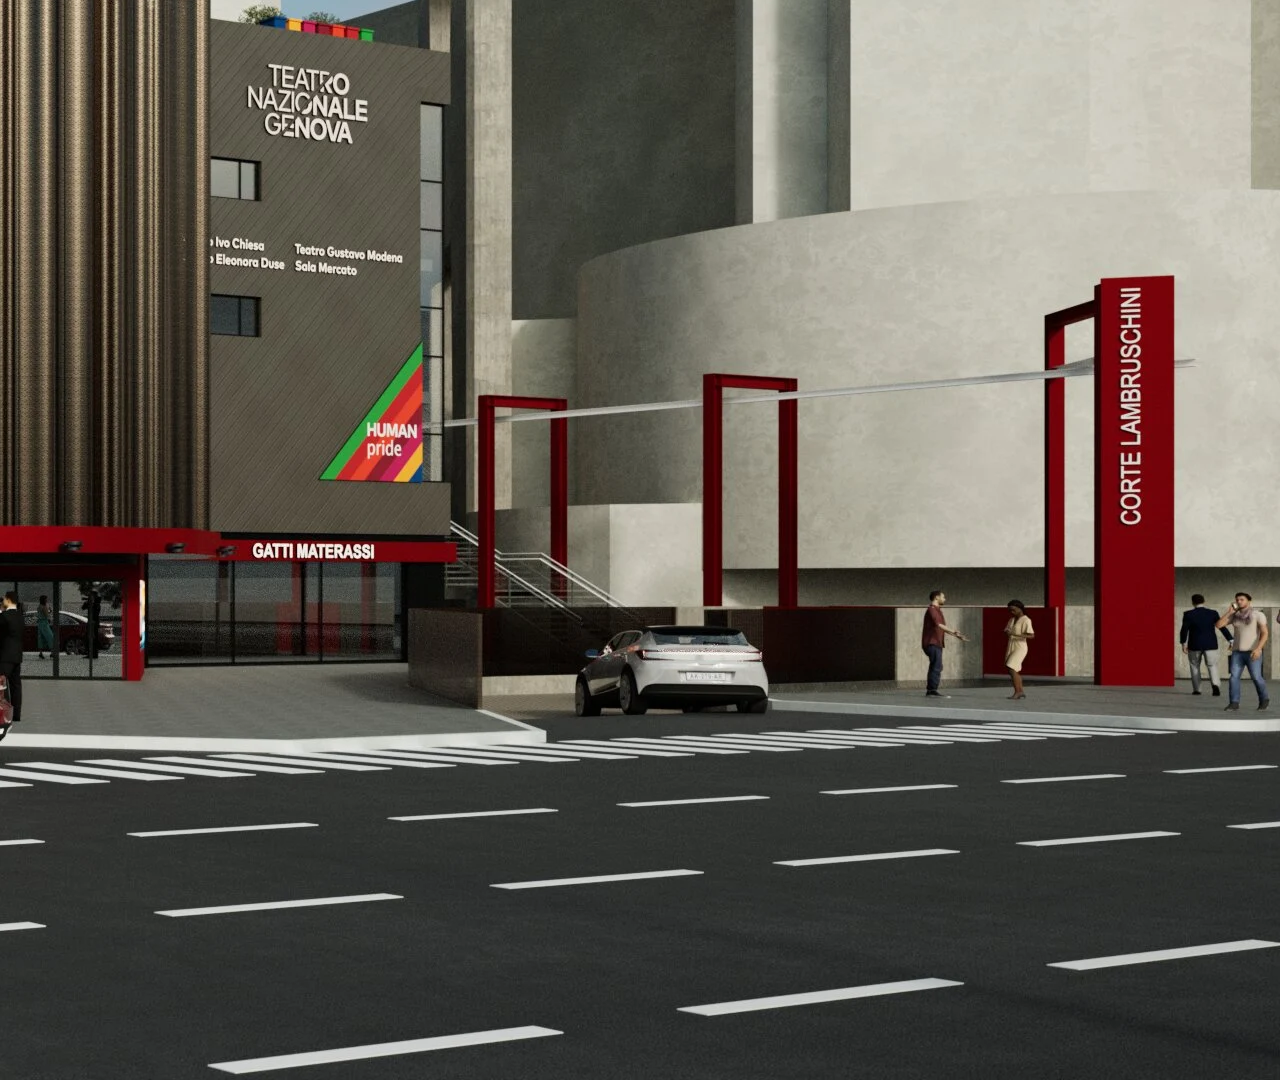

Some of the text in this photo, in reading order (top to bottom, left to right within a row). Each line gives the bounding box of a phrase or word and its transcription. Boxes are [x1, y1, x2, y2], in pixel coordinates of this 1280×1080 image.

[267, 63, 350, 95] TEATRO
[246, 84, 368, 122] NAZIONALE
[264, 112, 354, 144] GENOVA
[215, 236, 231, 248] Ivo
[231, 237, 265, 251] Chiesa
[215, 253, 259, 268] Eleonora
[260, 256, 286, 270] Duse
[294, 243, 403, 263] Teatro Gustavo Modena
[295, 260, 358, 276] Sala Mercato
[1119, 286, 1142, 526] CORTE LAMBRUSCHINI
[366, 422, 418, 439] HUMAN
[367, 441, 402, 459] pride
[252, 543, 375, 559] GATTI MATERASSI
